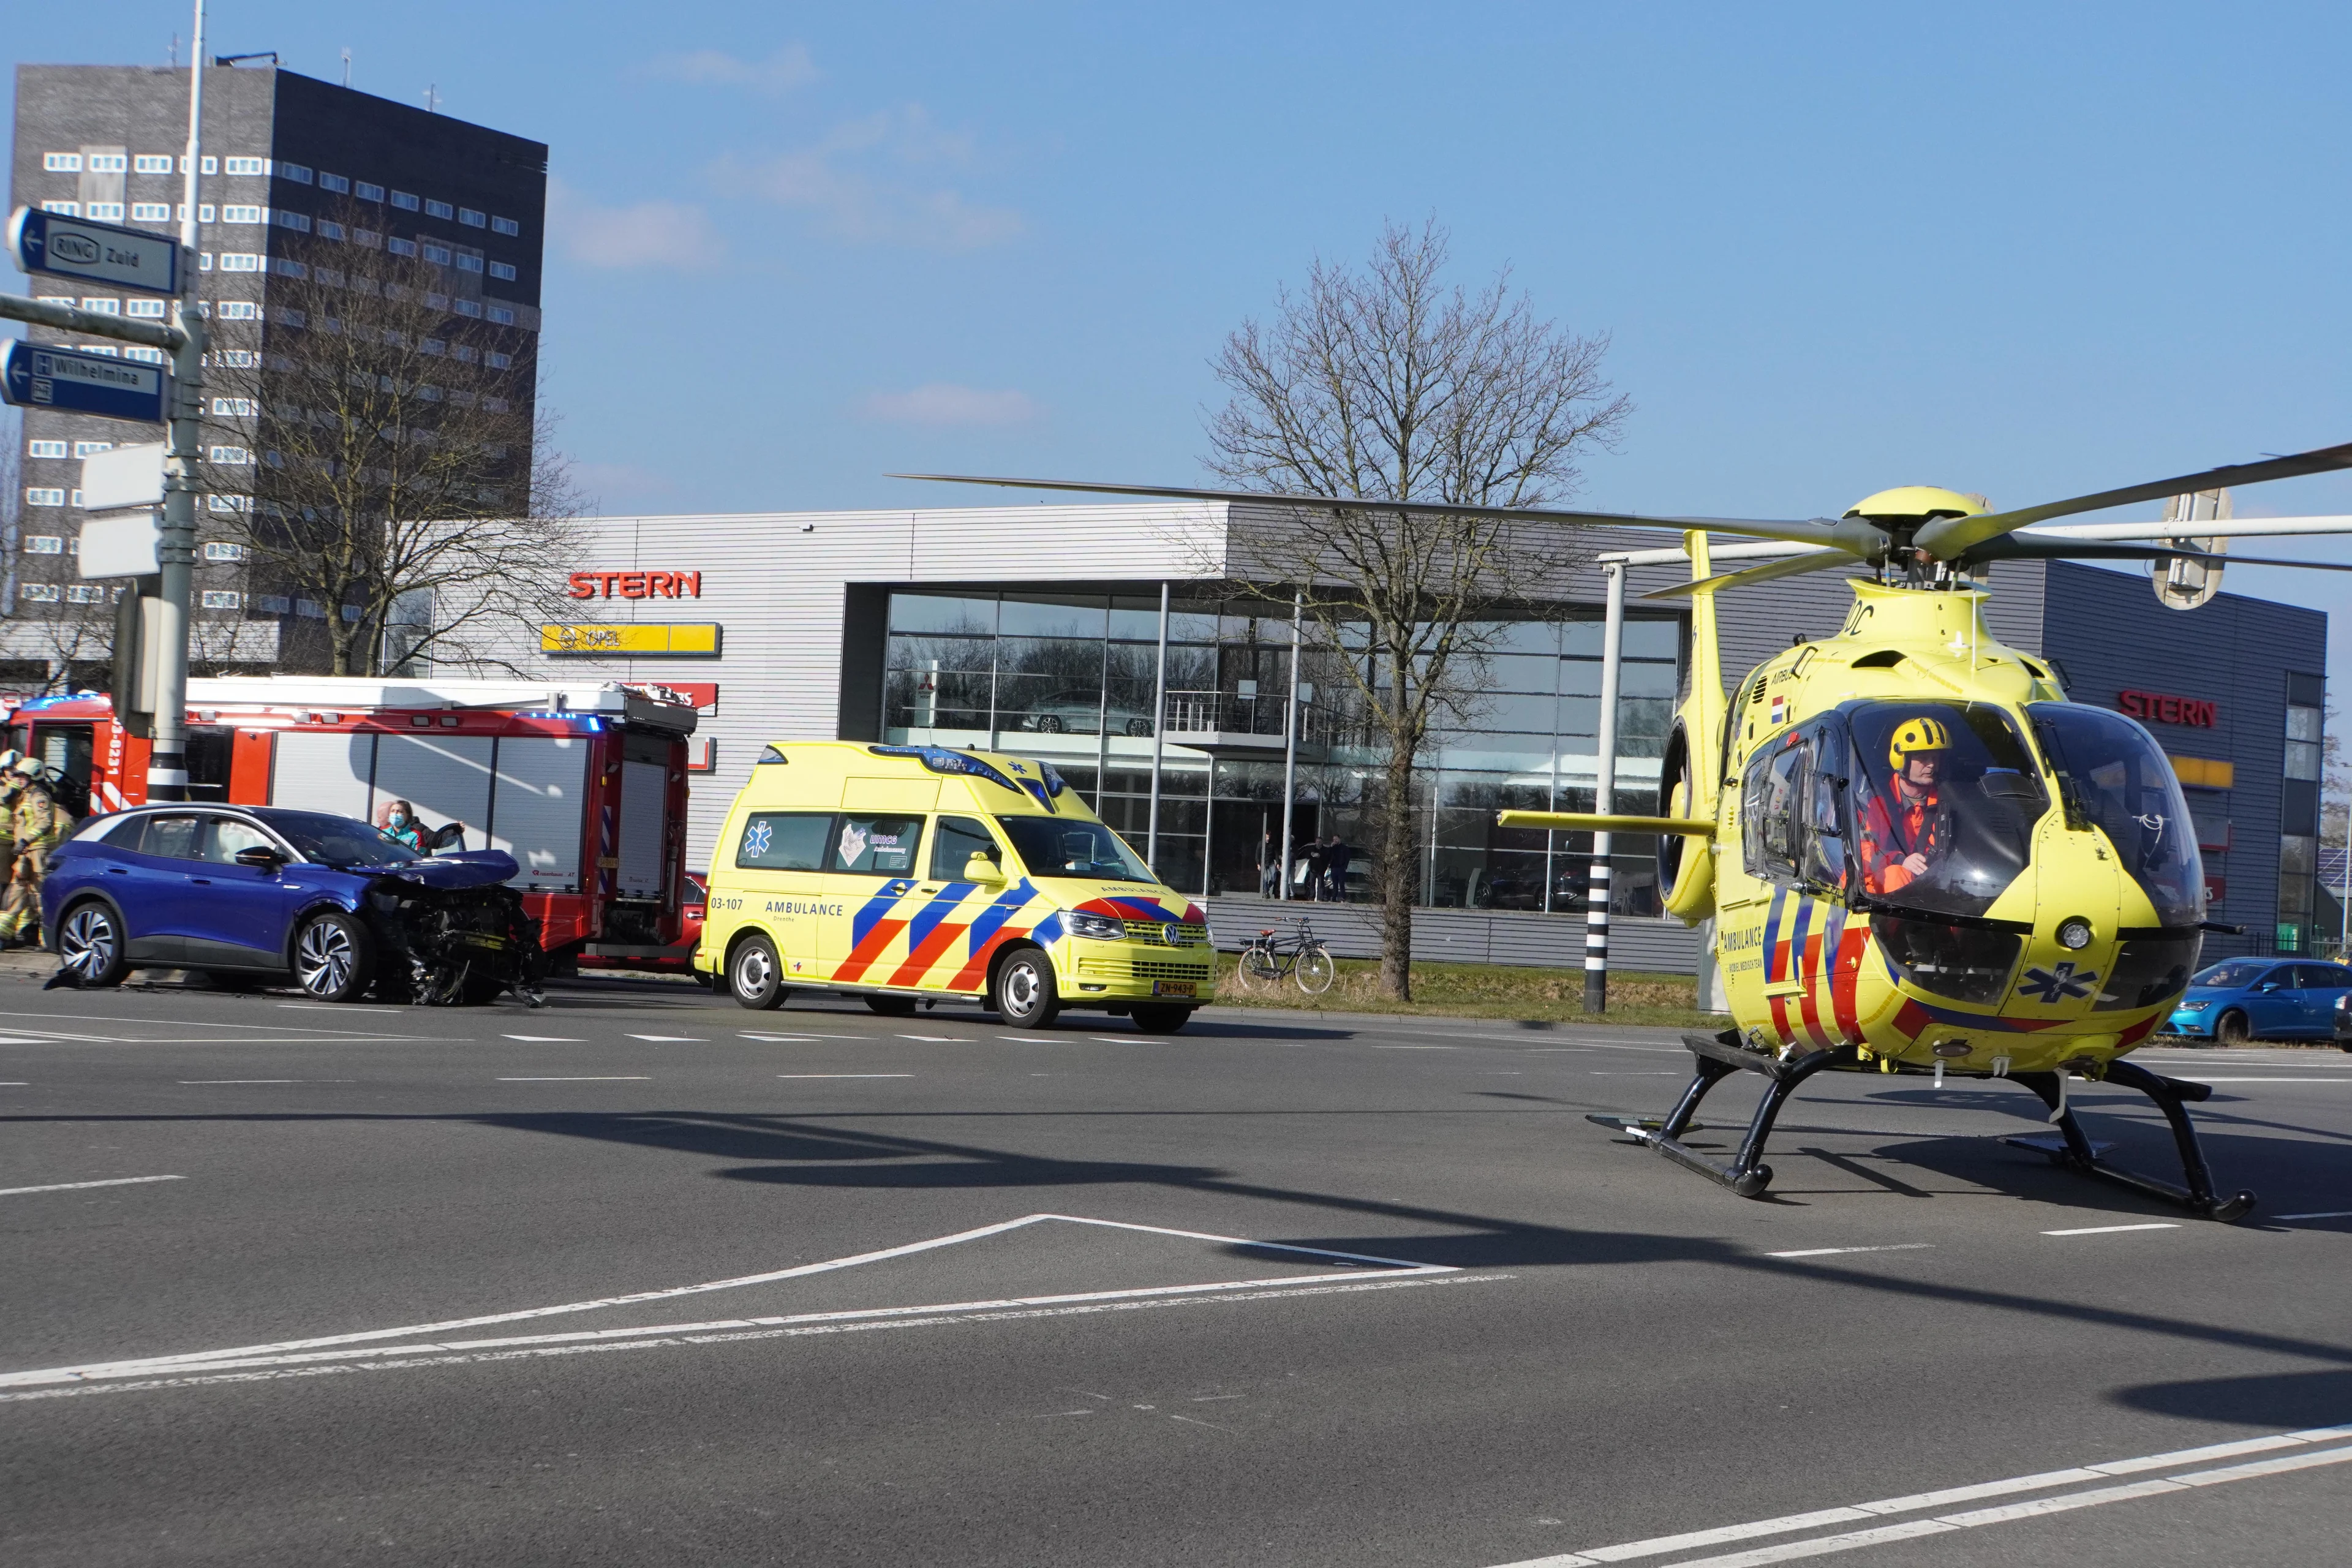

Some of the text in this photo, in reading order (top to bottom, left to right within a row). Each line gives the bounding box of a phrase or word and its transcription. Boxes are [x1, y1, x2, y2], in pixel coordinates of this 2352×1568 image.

[57, 238, 138, 268] RING Zuid
[54, 358, 138, 385] Wilhelmina
[568, 571, 701, 598] STERN
[586, 630, 620, 646] OPEL
[2119, 690, 2216, 728] STERN
[1101, 886, 1169, 896] AMBULANCE
[710, 897, 743, 910] 03-107
[765, 900, 843, 917] AMBULANCE
[1724, 925, 1762, 952] AMBULANCE
[1728, 958, 1763, 973] MOBIEL MEDISCH TEAM
[1161, 982, 1194, 993] ZN-943-P
